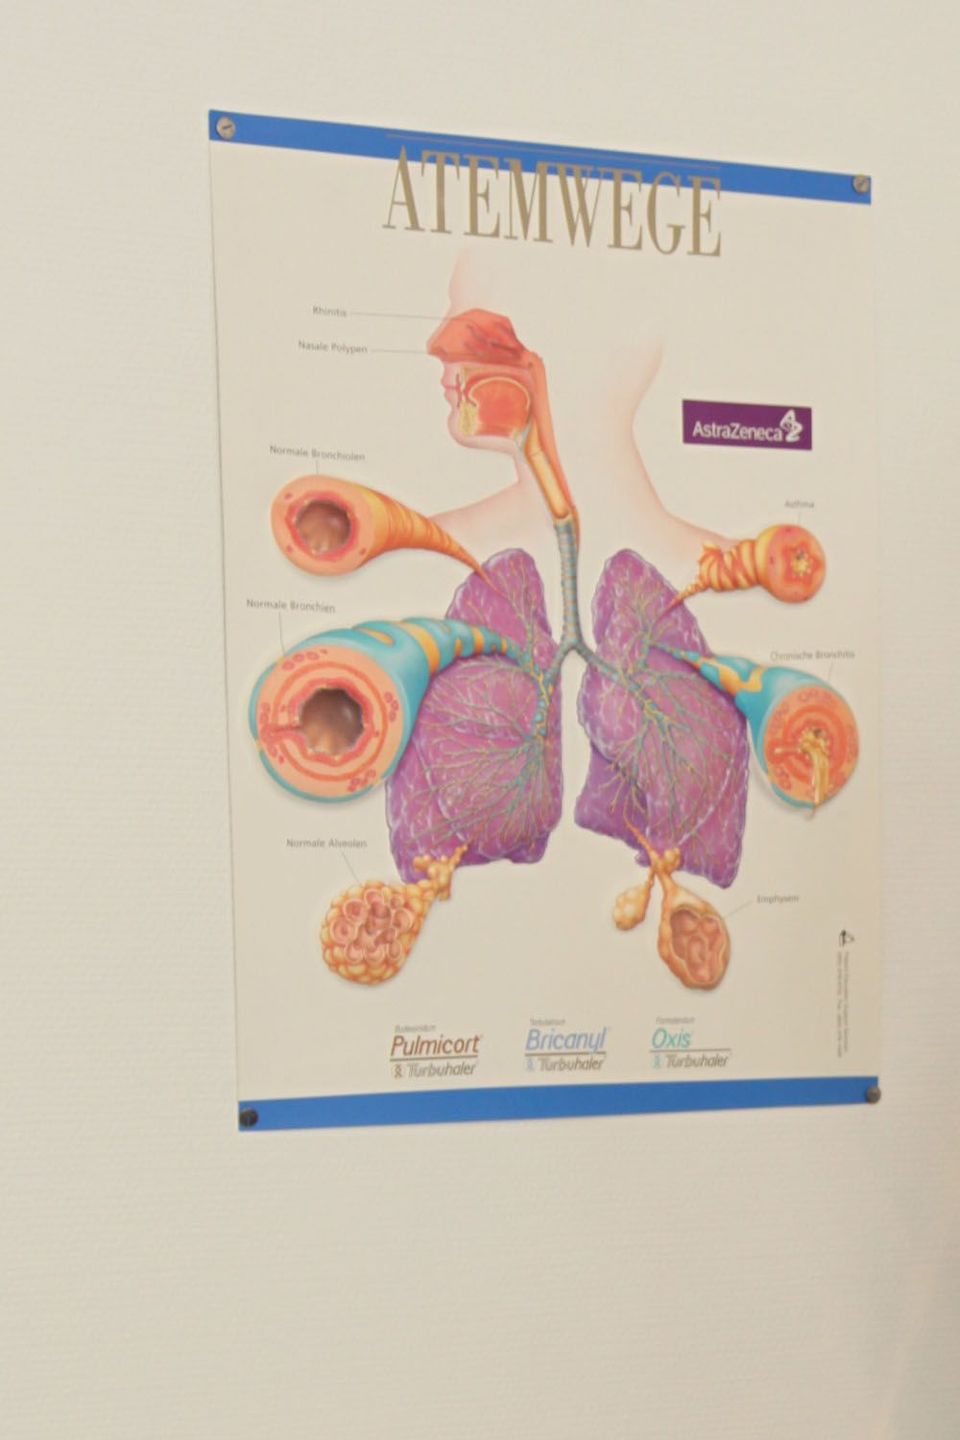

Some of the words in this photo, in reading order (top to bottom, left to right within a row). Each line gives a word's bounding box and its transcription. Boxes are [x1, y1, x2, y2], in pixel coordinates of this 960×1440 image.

[382, 145, 721, 257] ATEMWEGE
[692, 420, 783, 442] AstraZeneca
[270, 445, 308, 457] Normale
[246, 598, 287, 610] Normale
[286, 837, 326, 849] Normale
[391, 1033, 480, 1056] Pulmicort
[525, 1026, 607, 1054] Bricanyl
[652, 1026, 691, 1049] Oxis
[406, 1061, 477, 1078] Turbuhaler
[538, 1055, 605, 1073] Turbuhaler
[665, 1053, 729, 1069] Turbuhaler
